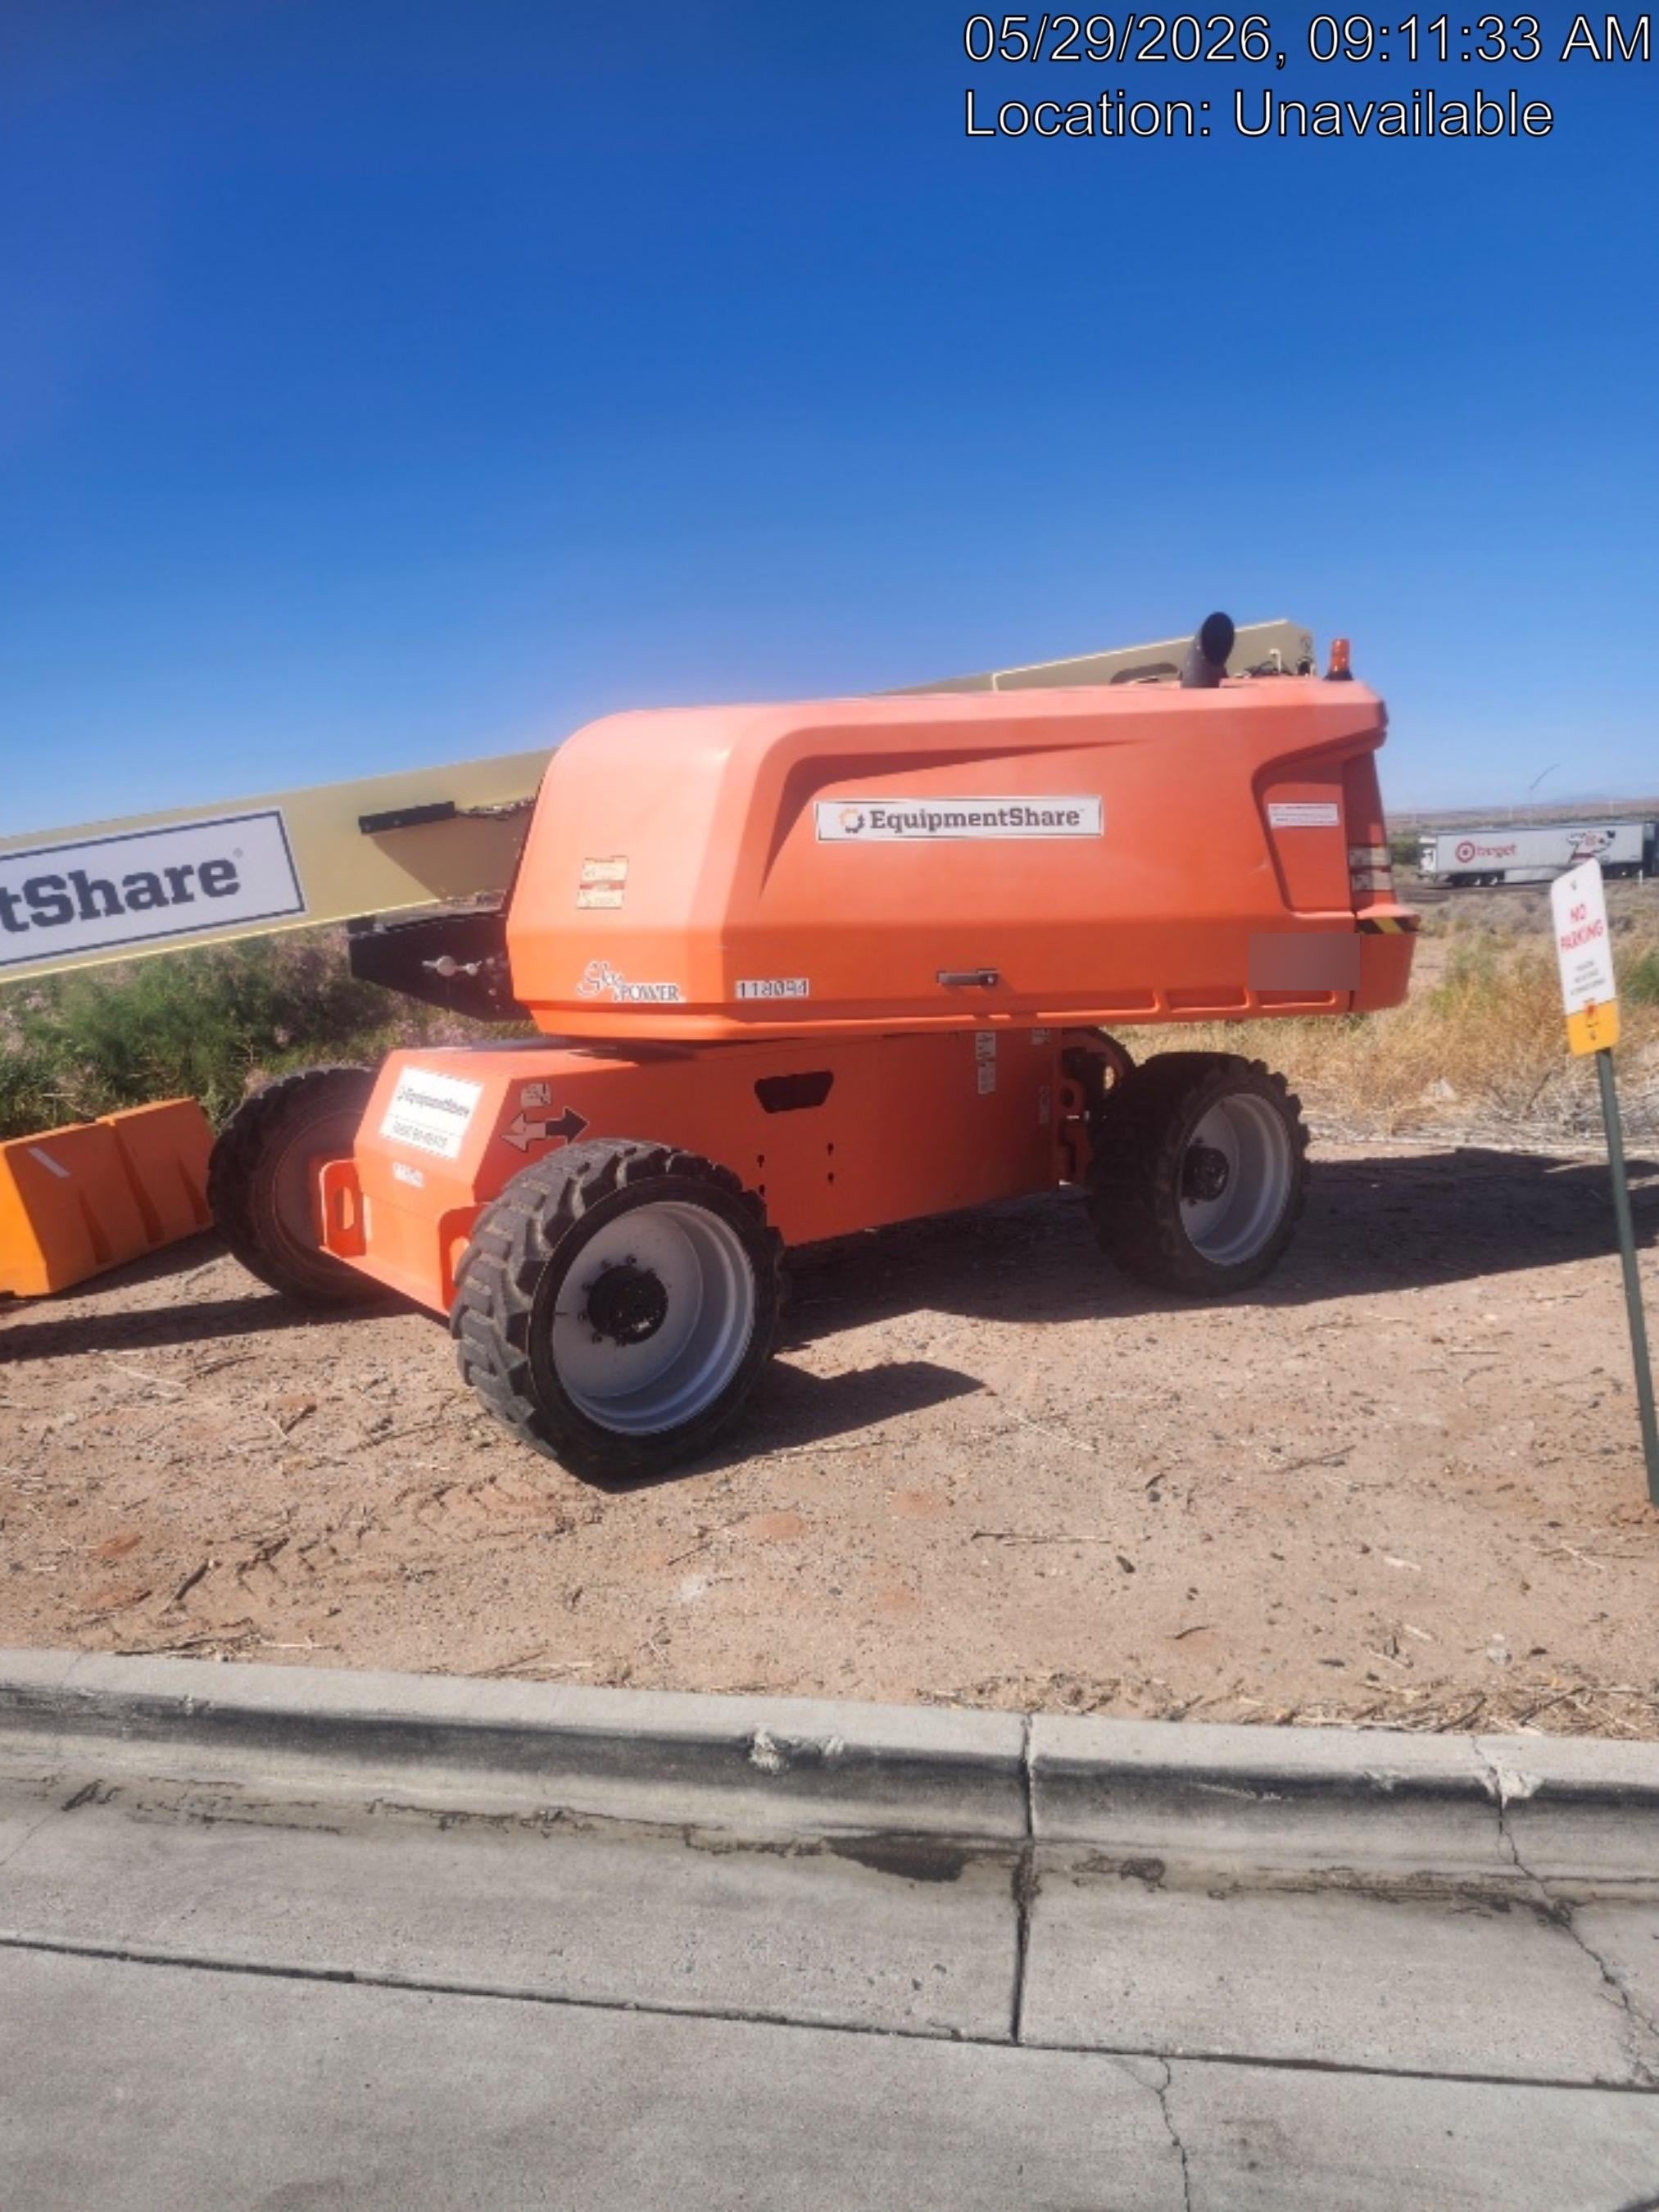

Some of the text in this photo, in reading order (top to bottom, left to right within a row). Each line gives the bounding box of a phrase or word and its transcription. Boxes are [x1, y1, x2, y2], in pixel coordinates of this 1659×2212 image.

[869, 807, 1081, 833] EquipmentShare
[1570, 904, 1587, 922] NO
[1560, 918, 1603, 951] PARKING
